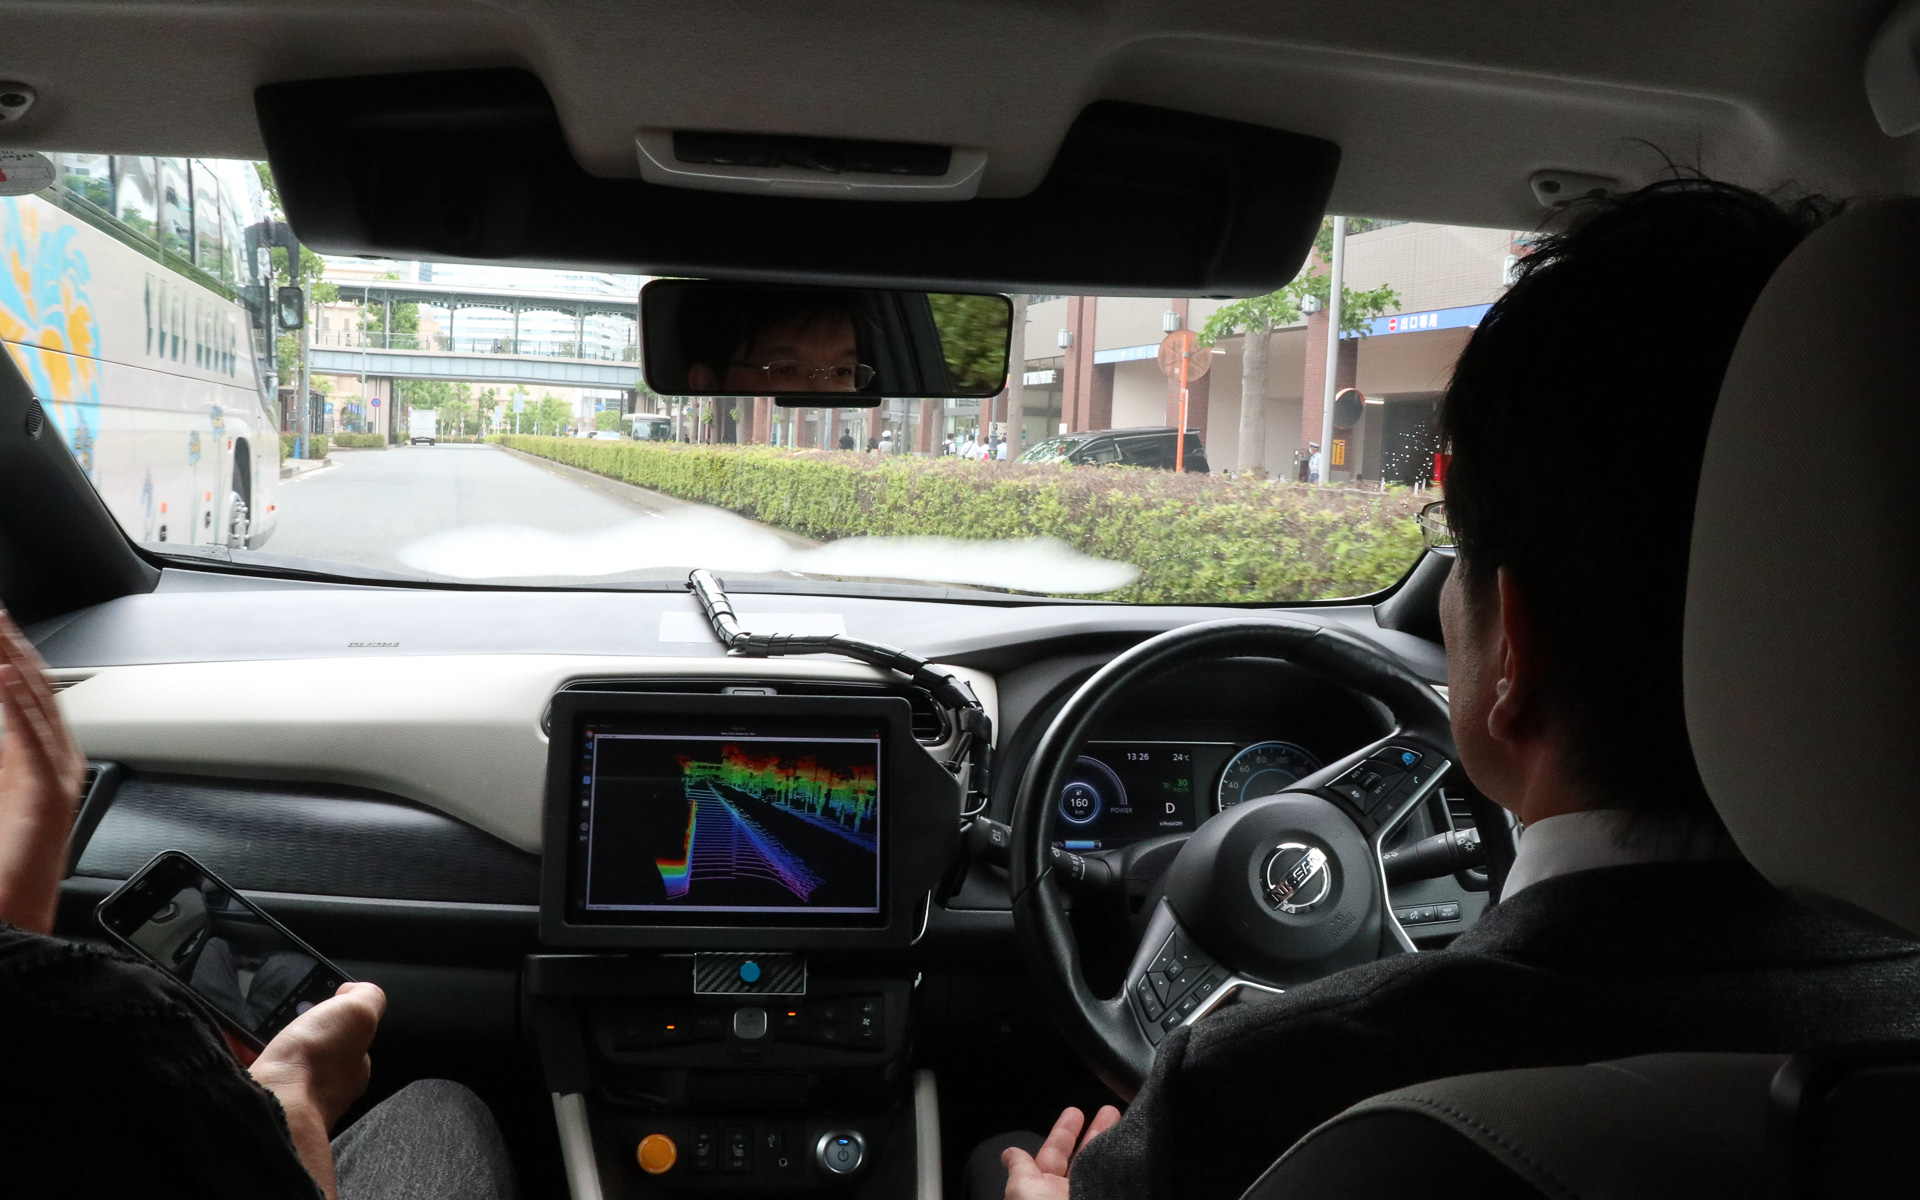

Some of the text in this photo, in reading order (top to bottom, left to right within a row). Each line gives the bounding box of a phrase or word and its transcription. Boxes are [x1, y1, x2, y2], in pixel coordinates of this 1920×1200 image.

[1400, 313, 1438, 330] 出口専用
[326, 404, 332, 412] P
[1256, 756, 1267, 764] 80
[1276, 756, 1289, 764] 100
[1239, 765, 1250, 773] 60
[1177, 779, 1188, 787] 30
[1228, 781, 1239, 789] 40
[1070, 798, 1088, 807] 160
[1165, 802, 1176, 814] D
[1271, 853, 1321, 902] NISSAN
